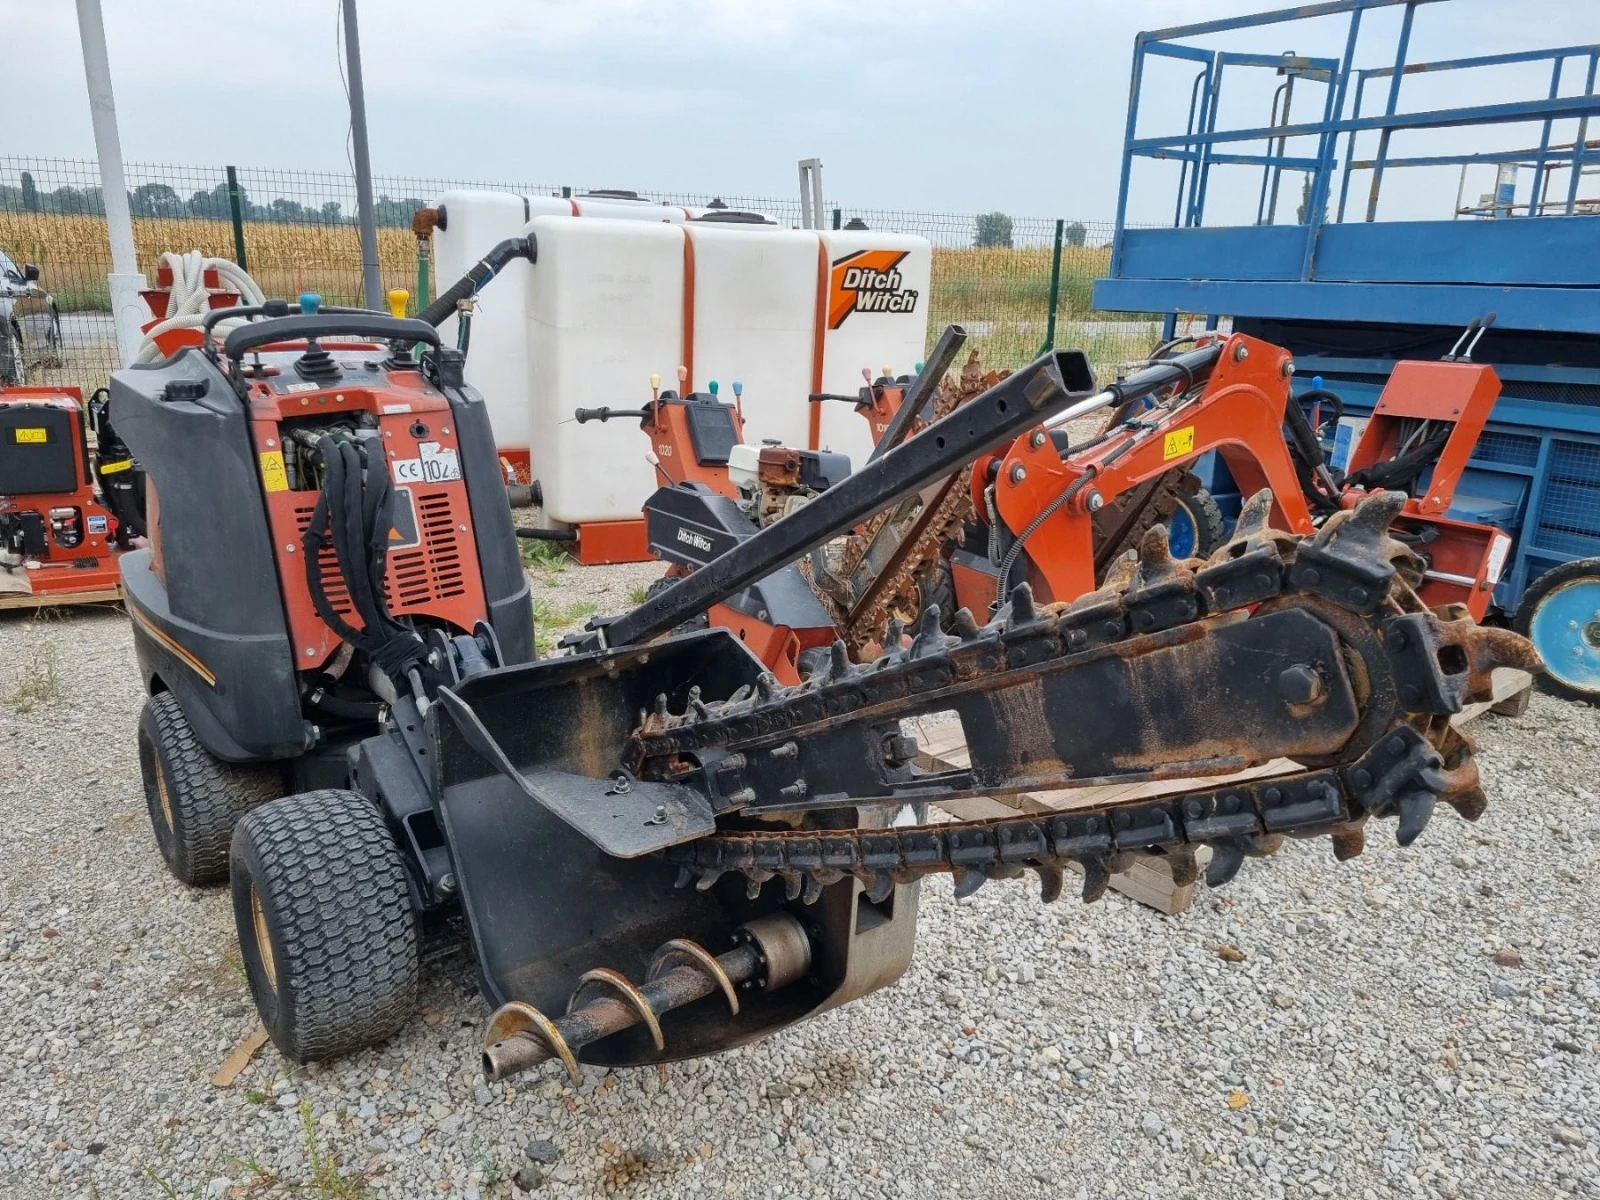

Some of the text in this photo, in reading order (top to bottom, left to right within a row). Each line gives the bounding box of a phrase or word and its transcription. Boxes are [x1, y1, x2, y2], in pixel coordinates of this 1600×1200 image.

[843, 268, 900, 289] Ditch
[856, 291, 915, 311] Witch
[658, 444, 672, 457] 1020
[398, 463, 418, 478] CE
[677, 529, 711, 552] Ditch Witch
